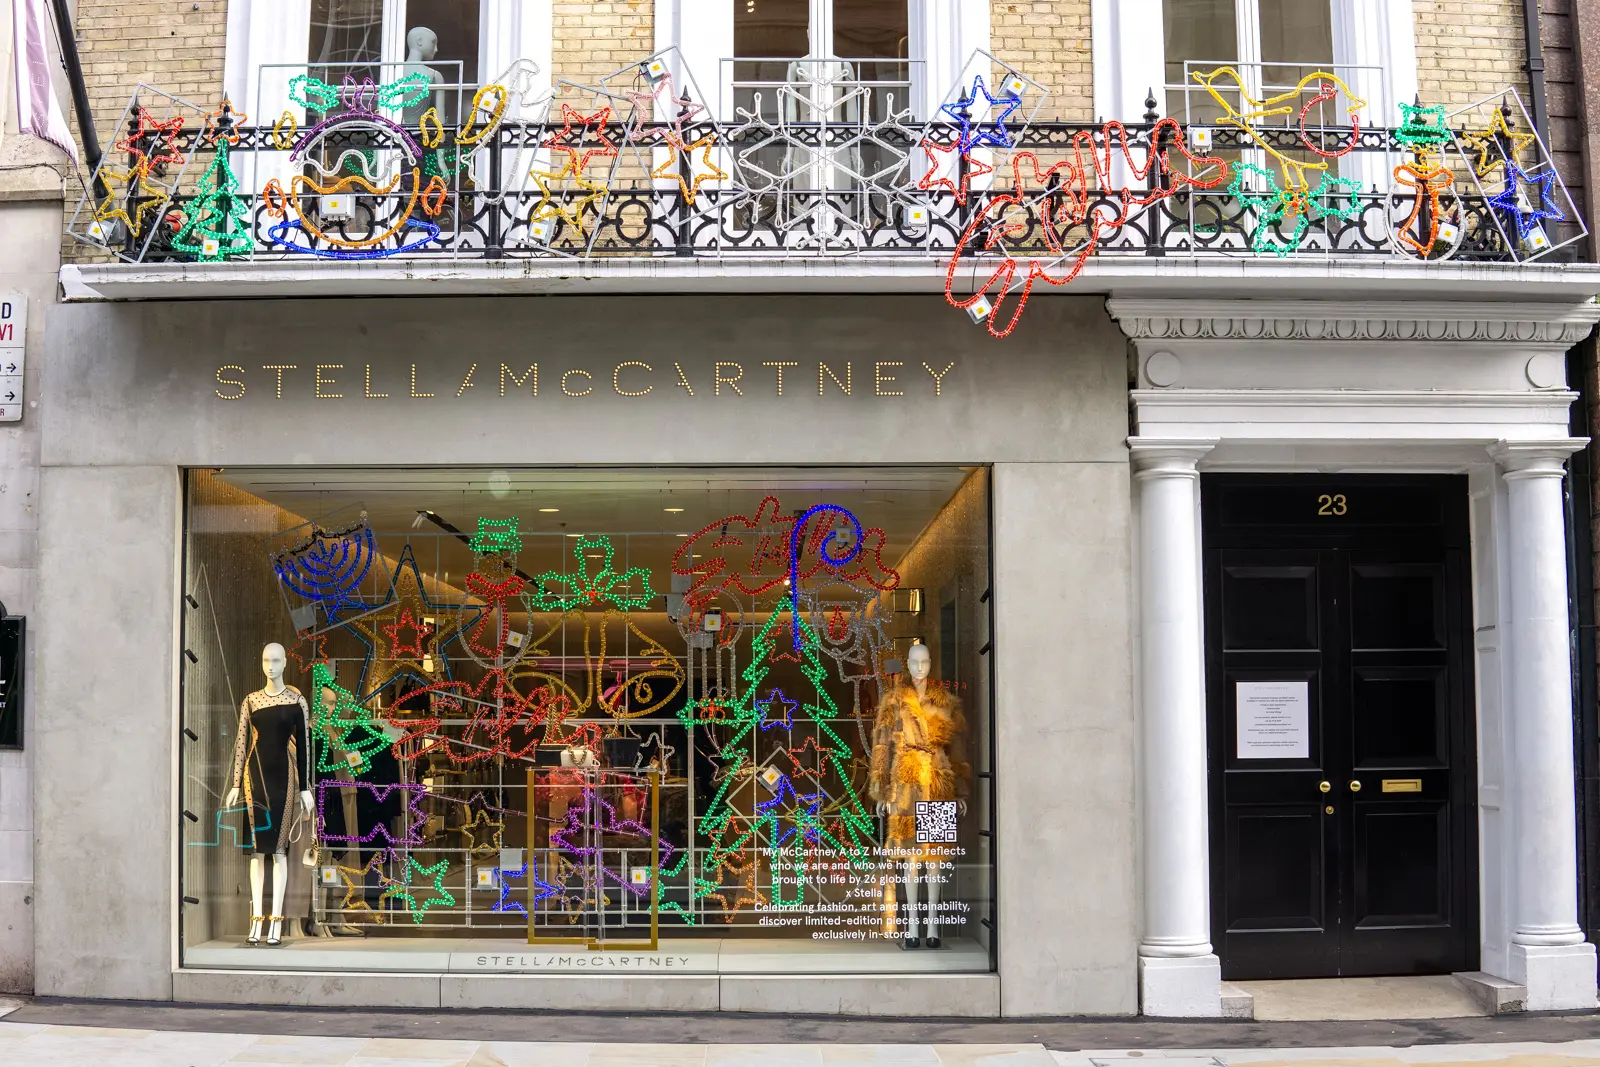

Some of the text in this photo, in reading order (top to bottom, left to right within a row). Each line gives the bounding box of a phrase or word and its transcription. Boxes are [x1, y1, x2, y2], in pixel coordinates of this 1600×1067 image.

[1318, 493, 1347, 515] 23
[780, 847, 836, 858] McCartney
[839, 847, 847, 856] A
[849, 847, 860, 856] to
[863, 848, 870, 856] Z
[873, 847, 923, 856] Manifesto
[926, 846, 966, 856] reflects
[769, 861, 791, 870] who
[831, 861, 850, 870] and
[853, 861, 875, 870] who
[878, 862, 893, 870] we
[896, 861, 925, 871] hope
[926, 861, 936, 870] to
[939, 860, 955, 871] be,
[771, 874, 813, 886] brought
[816, 876, 827, 884] to
[830, 874, 846, 884] life
[849, 875, 861, 885] by
[864, 874, 877, 883] 26
[880, 874, 910, 885] global
[845, 888, 883, 898] x Stella
[754, 901, 970, 914] Celebrating fashion, art and sustainability,
[759, 915, 967, 926] discover limited-edition pieces available
[812, 929, 913, 940] exclusively in-store.
